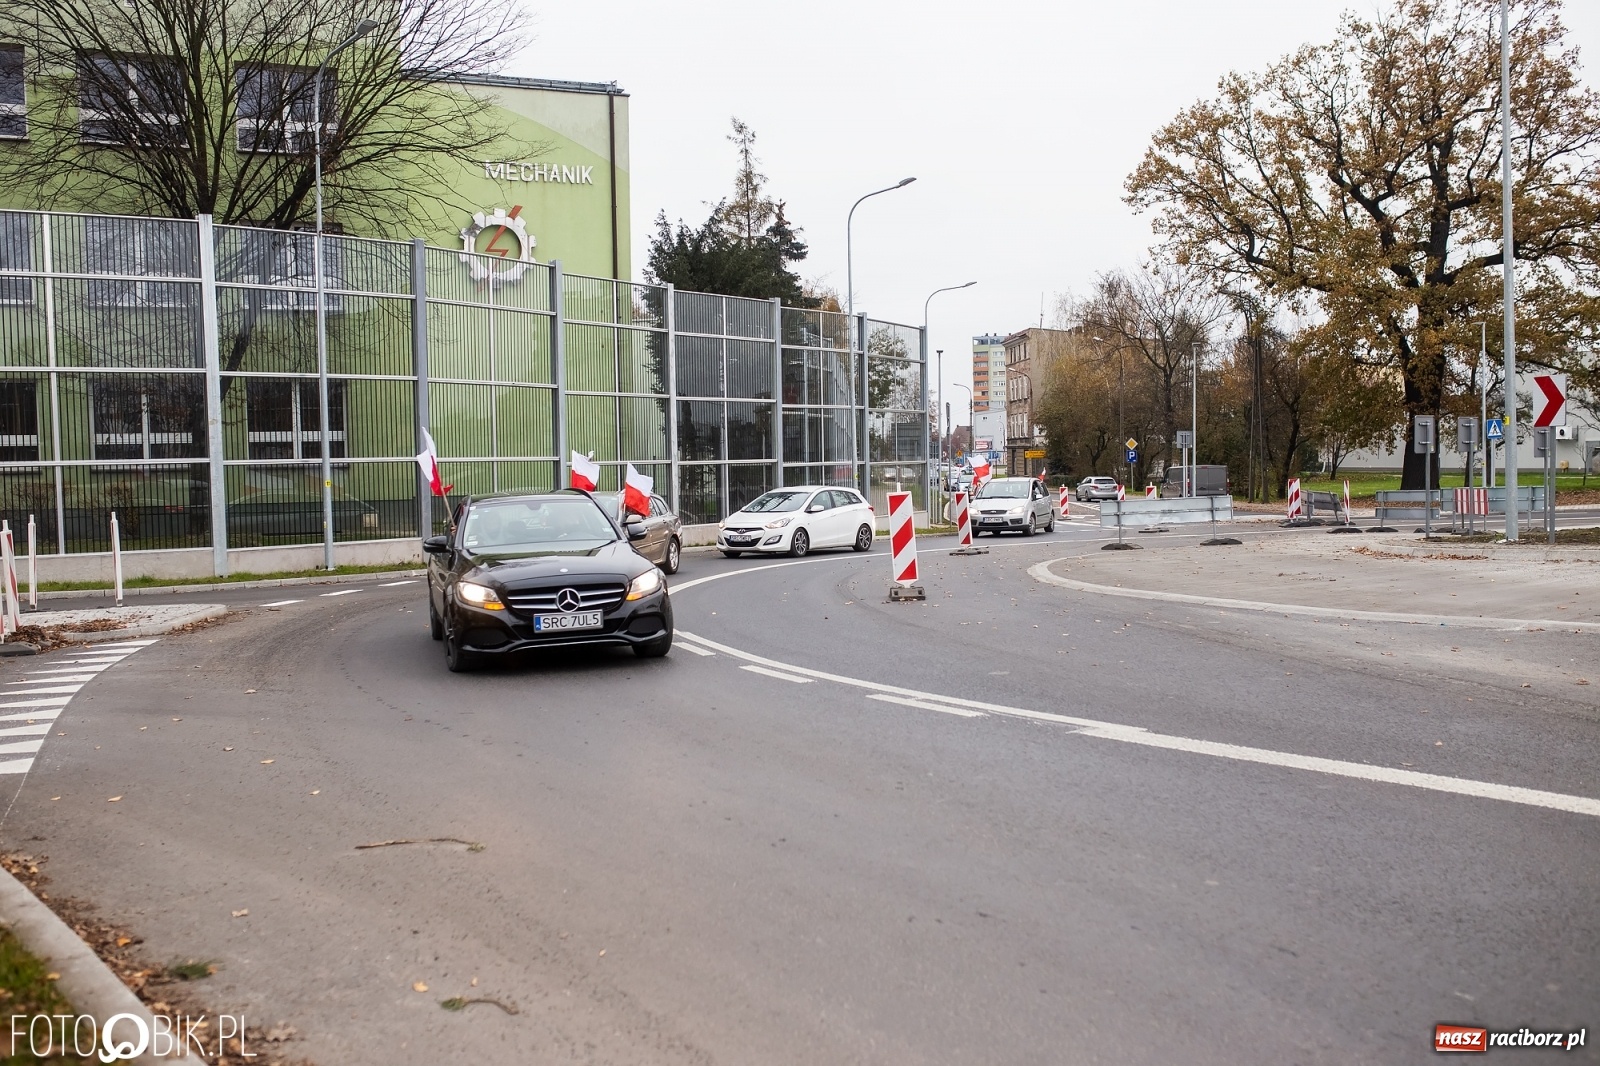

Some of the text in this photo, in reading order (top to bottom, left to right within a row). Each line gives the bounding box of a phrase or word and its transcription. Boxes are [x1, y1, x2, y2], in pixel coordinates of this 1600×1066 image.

[485, 160, 594, 185] MECHANIK
[542, 613, 600, 629] SRC 7UL5
